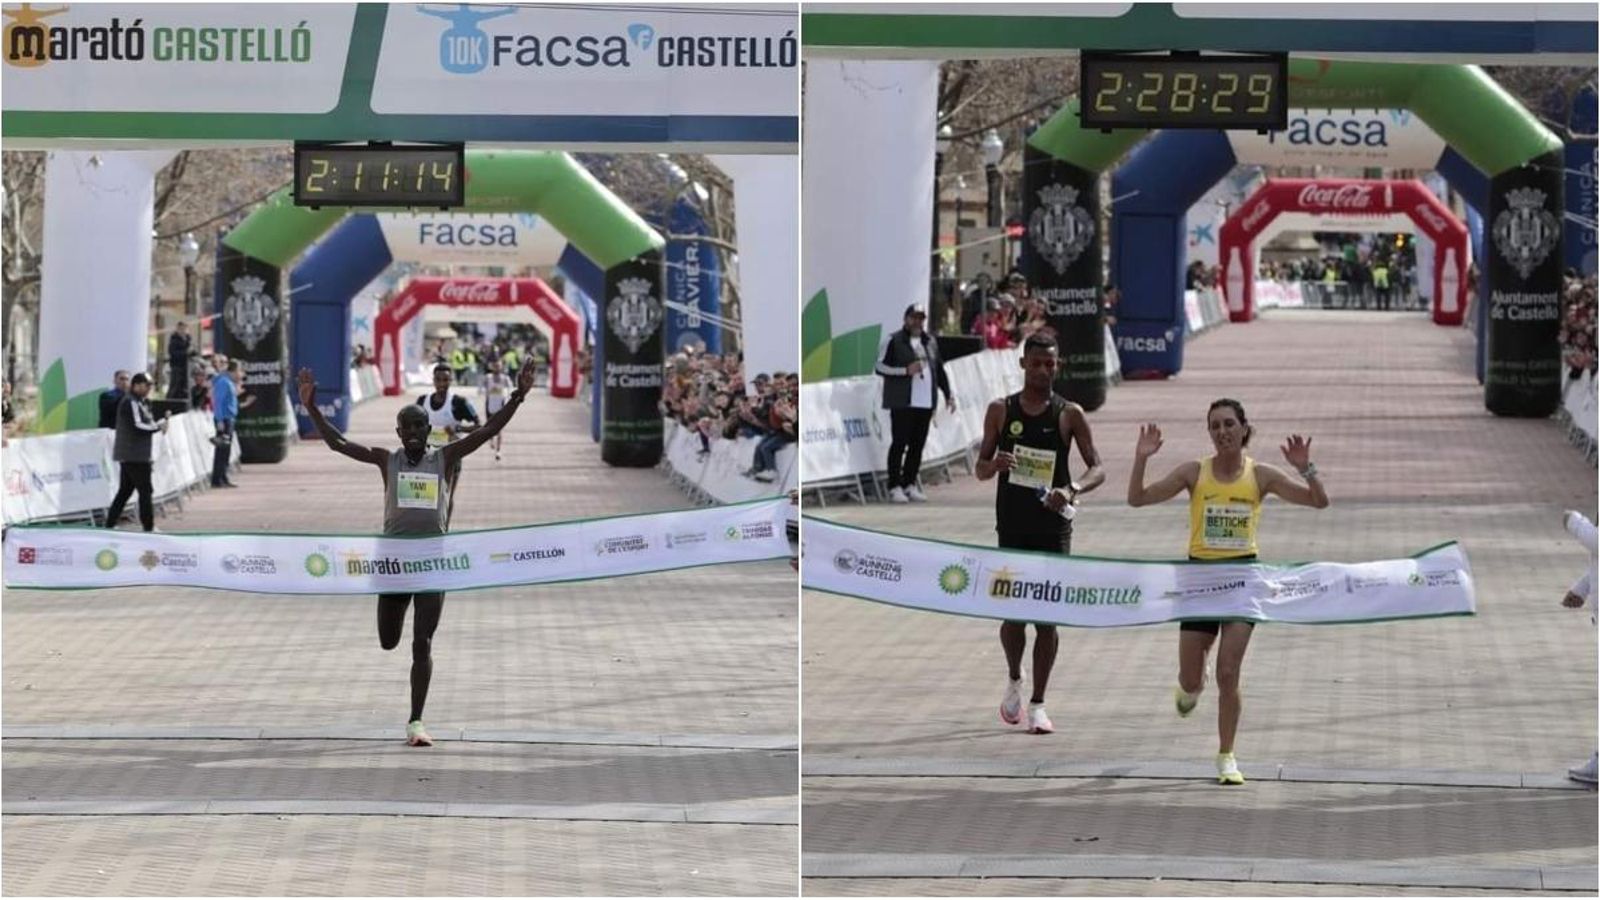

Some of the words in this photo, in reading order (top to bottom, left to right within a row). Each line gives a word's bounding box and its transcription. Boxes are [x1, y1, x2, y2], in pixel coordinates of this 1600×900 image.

[9, 18, 144, 60] marató
[152, 21, 312, 62] CASTELLÓ
[447, 36, 484, 65] 10K
[657, 30, 798, 68] CASTELLÓ
[1095, 73, 1272, 113] 2:28:29
[306, 159, 453, 192] 2:11:14
[419, 222, 519, 249] Facsa
[1491, 289, 1558, 305] Ajuntament
[1491, 305, 1504, 320] de
[1507, 305, 1559, 320] Castelló
[1206, 515, 1249, 528] BETTICHE
